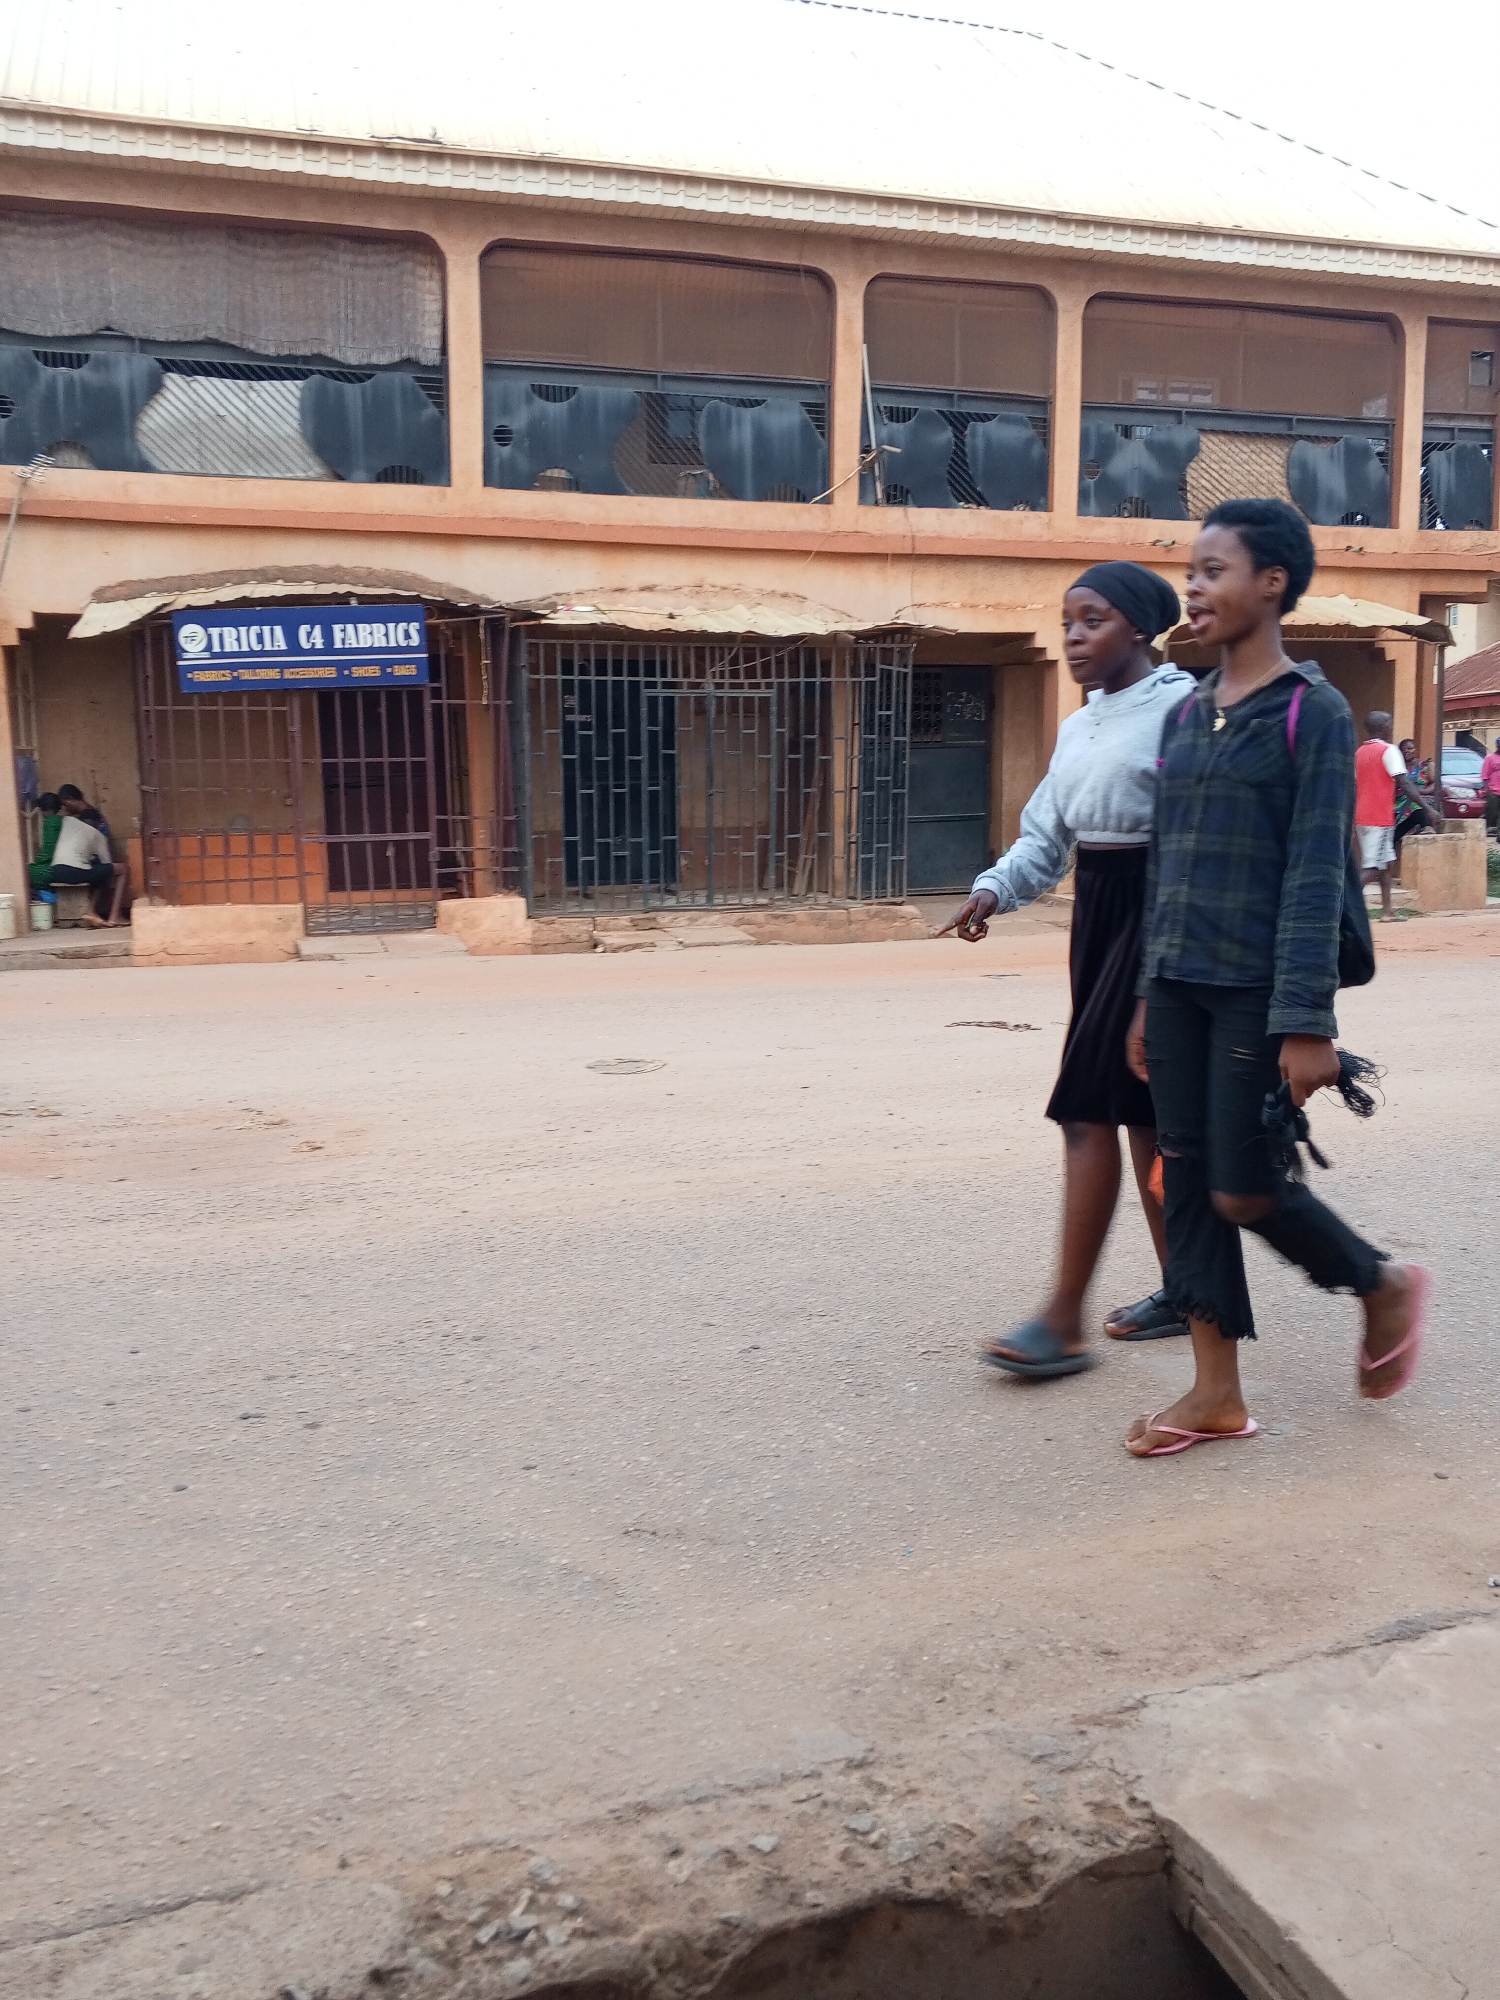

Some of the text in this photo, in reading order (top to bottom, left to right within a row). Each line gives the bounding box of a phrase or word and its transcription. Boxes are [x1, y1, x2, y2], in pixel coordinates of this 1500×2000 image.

[207, 625, 287, 652] TRICIA
[298, 624, 324, 649] C4
[331, 622, 421, 649] FABRICS
